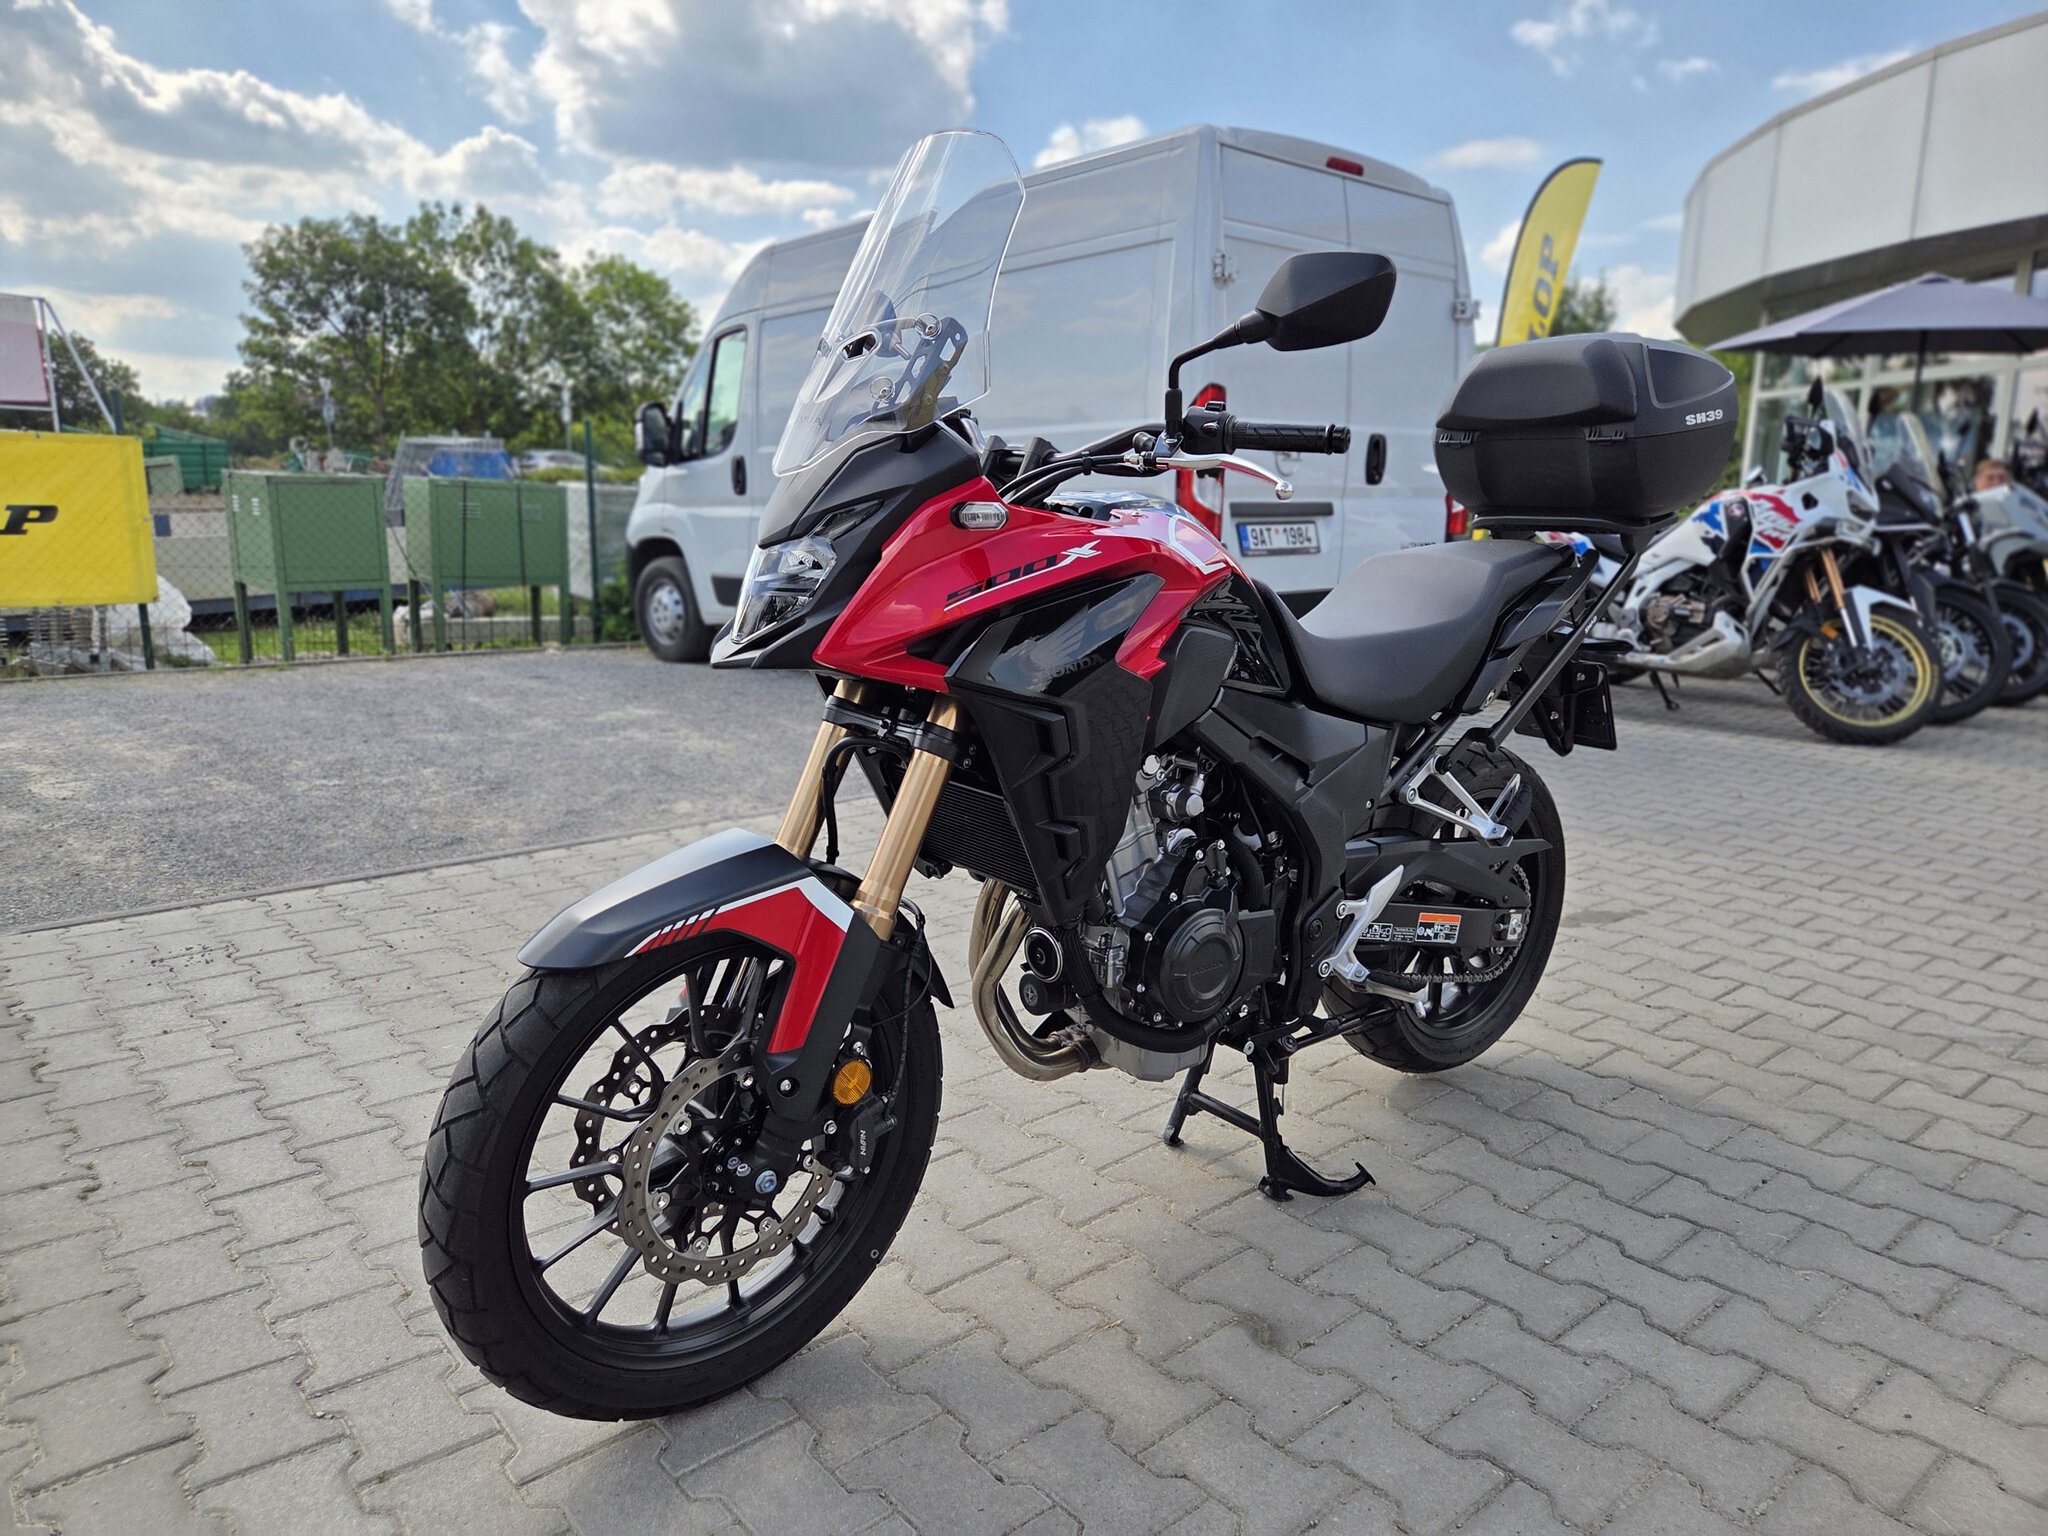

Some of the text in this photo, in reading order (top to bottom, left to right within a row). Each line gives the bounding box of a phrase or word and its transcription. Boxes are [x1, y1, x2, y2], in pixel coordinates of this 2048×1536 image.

[1684, 408, 1724, 426] SH39
[1250, 526, 1313, 547] 9AT 1984
[943, 539, 1103, 611] 500X
